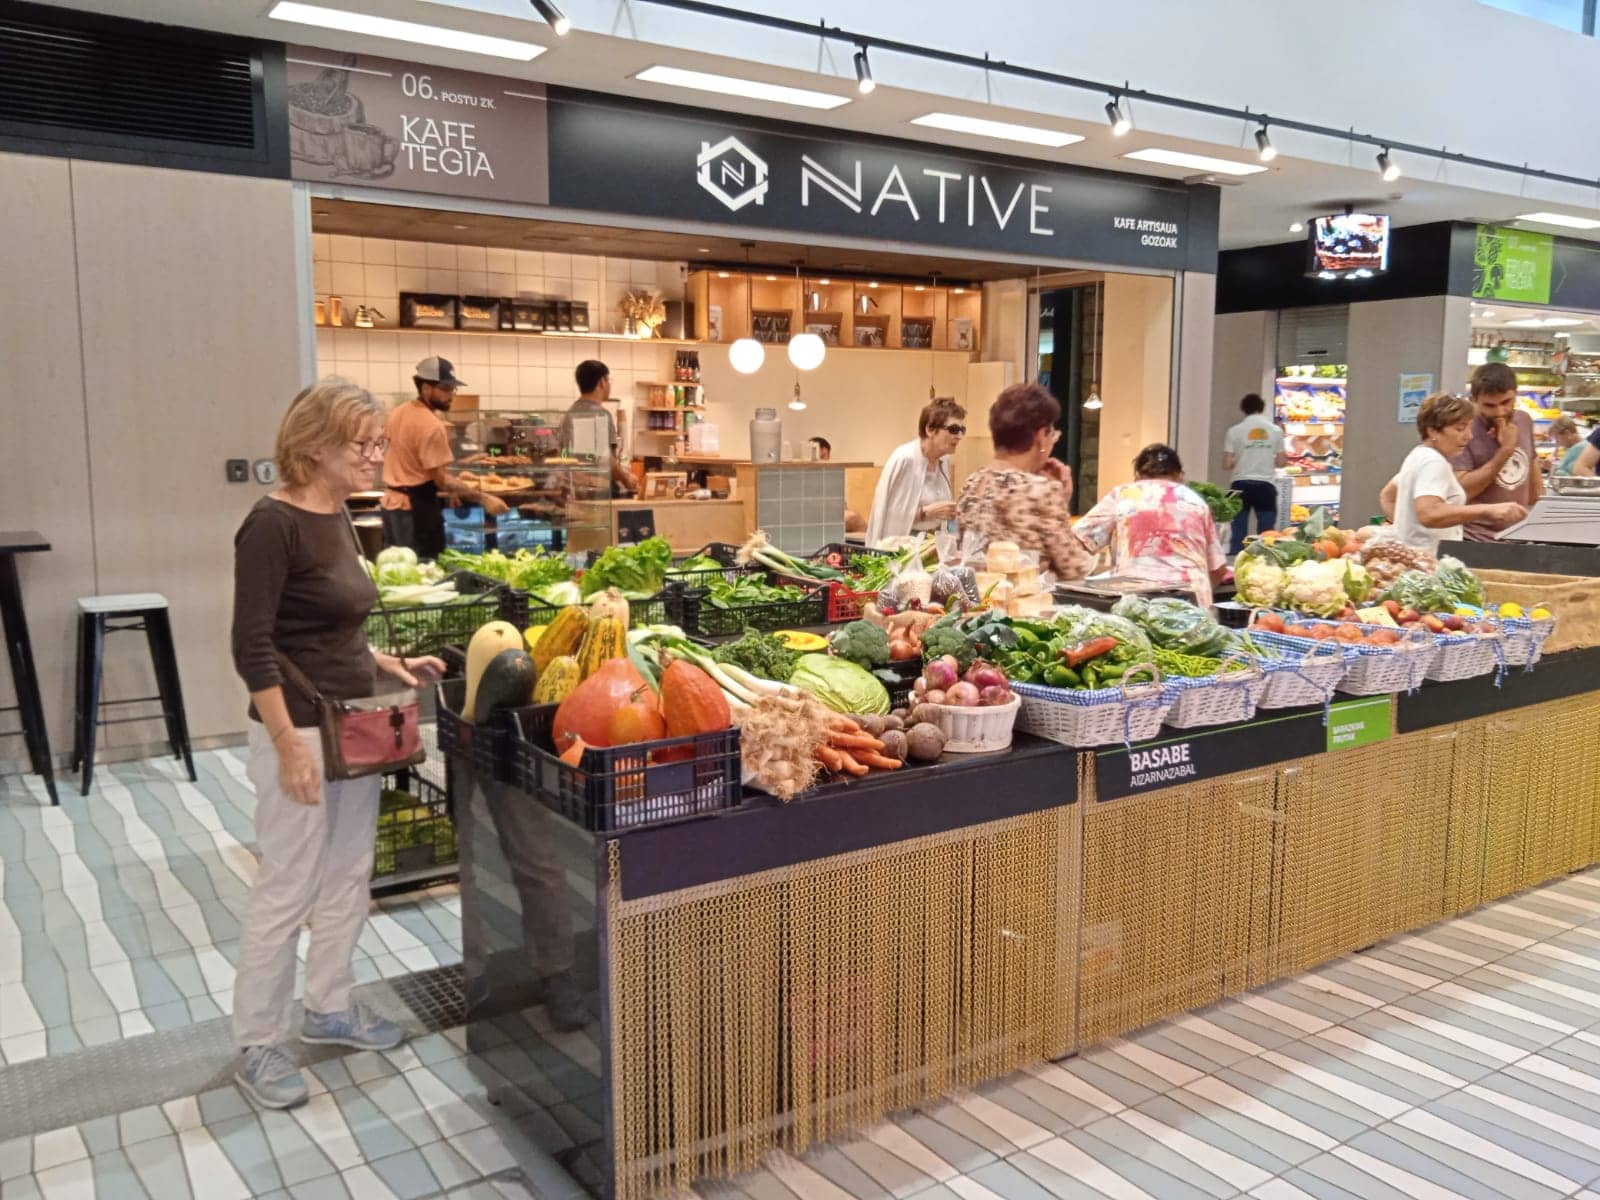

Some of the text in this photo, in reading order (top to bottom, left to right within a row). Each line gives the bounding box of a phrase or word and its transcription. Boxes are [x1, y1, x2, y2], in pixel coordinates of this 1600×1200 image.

[402, 73, 497, 109] 06. POSTU ZK.
[400, 114, 477, 151] KAFE
[401, 142, 495, 179] TEGIA
[801, 154, 1055, 236] NATIVE
[1113, 217, 1178, 234] KAFE ARTISAUA
[1141, 235, 1178, 248] GOZOAK
[1130, 743, 1191, 772] BASABE
[1130, 763, 1196, 788] AIZARNAZABAL
